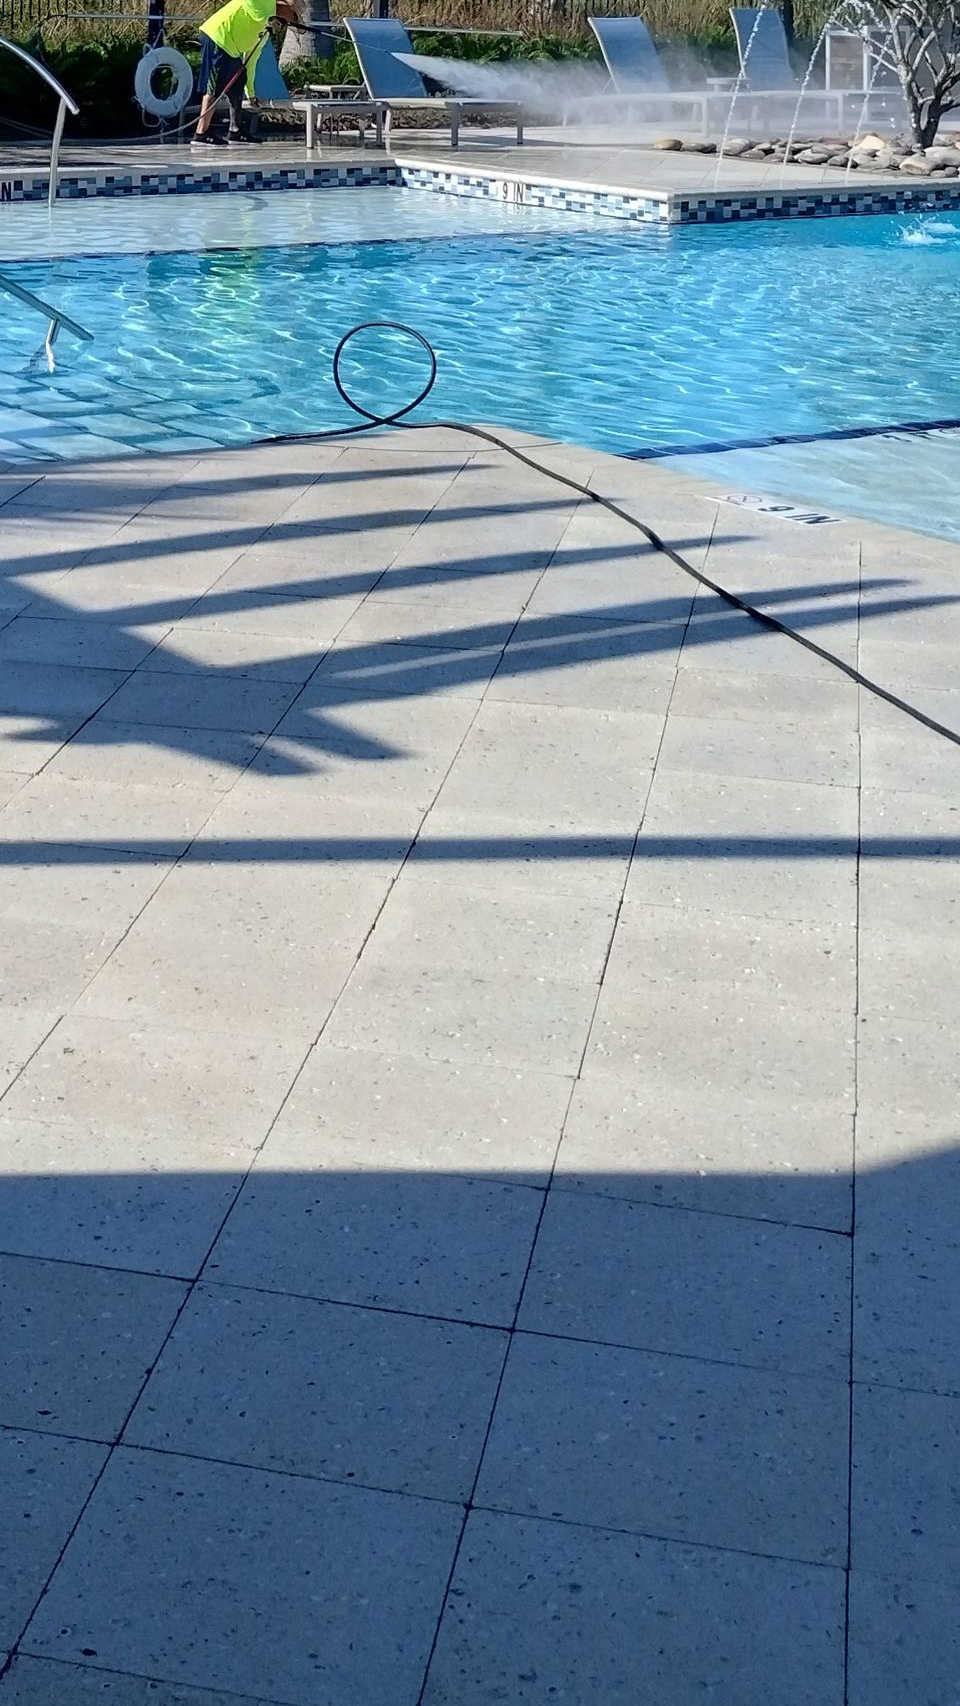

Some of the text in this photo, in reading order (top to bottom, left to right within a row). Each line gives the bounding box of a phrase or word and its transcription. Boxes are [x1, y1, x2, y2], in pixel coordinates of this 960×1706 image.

[502, 181, 524, 203] 9 IN
[784, 512, 843, 525] IN
